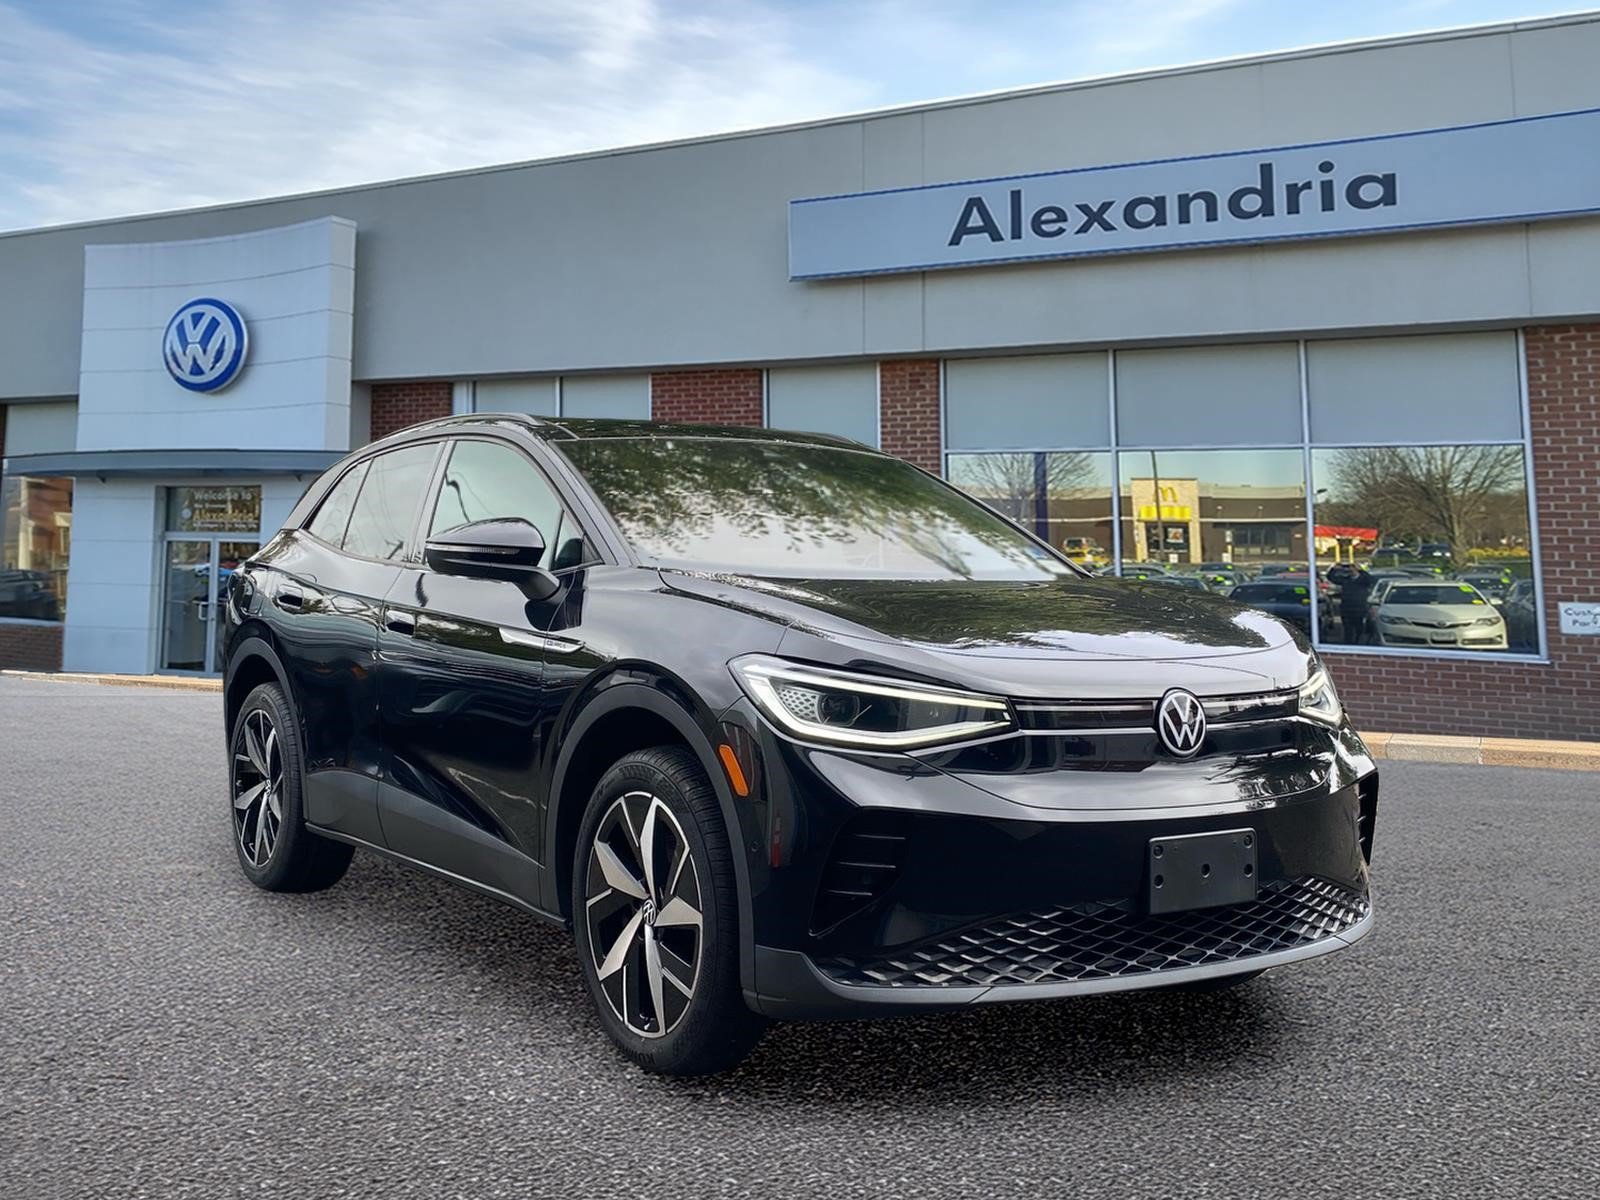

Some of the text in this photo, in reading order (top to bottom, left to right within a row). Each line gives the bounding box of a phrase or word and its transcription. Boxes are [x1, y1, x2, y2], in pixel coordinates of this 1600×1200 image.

[948, 161, 1398, 246] Alexandria
[166, 305, 237, 383] VW
[194, 490, 252, 500] Welcome to
[1160, 694, 1204, 750] VW
